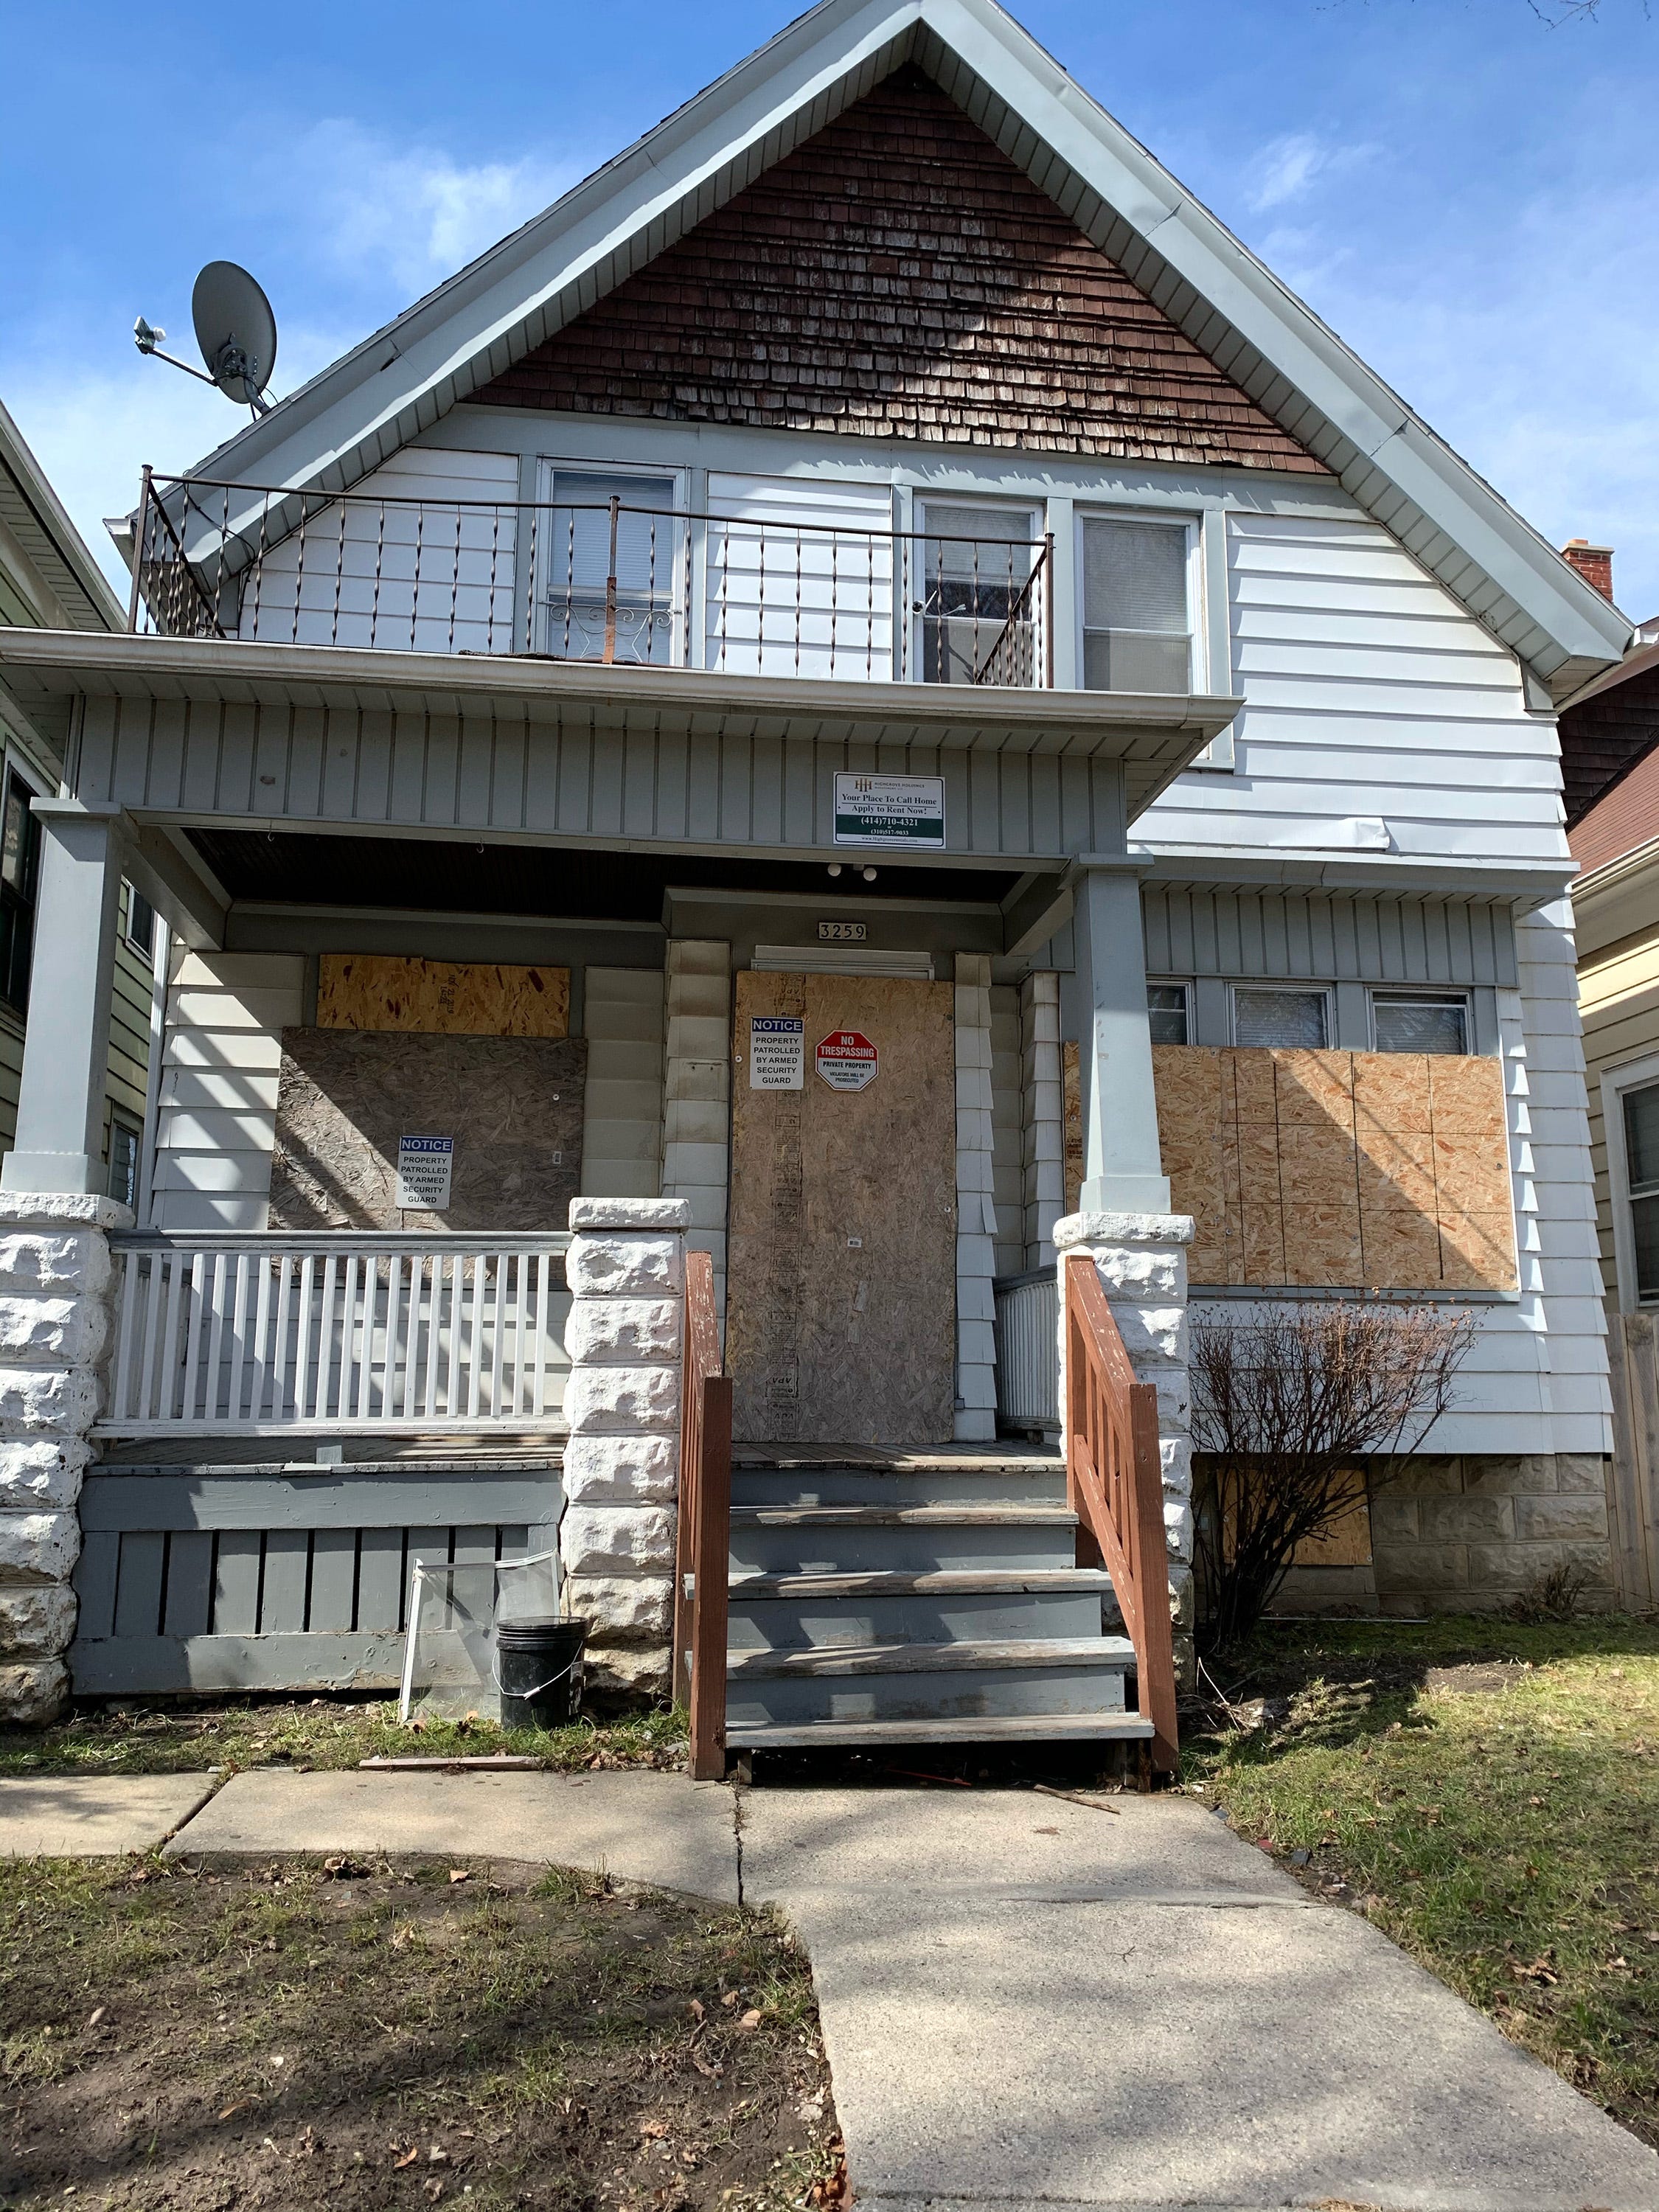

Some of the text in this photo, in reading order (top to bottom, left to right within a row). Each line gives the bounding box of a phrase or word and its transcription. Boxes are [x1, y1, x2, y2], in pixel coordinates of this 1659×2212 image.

[842, 793, 860, 801] Your
[852, 805, 874, 813] Apply
[861, 816, 918, 827] (414)710-4321
[821, 925, 864, 938] 3259
[753, 1020, 801, 1031] NOTICE
[841, 1035, 854, 1046] NO
[821, 1046, 874, 1057] TRESPASSING
[402, 1139, 451, 1151] NOTICE
[400, 1166, 448, 1174] PATROLLED
